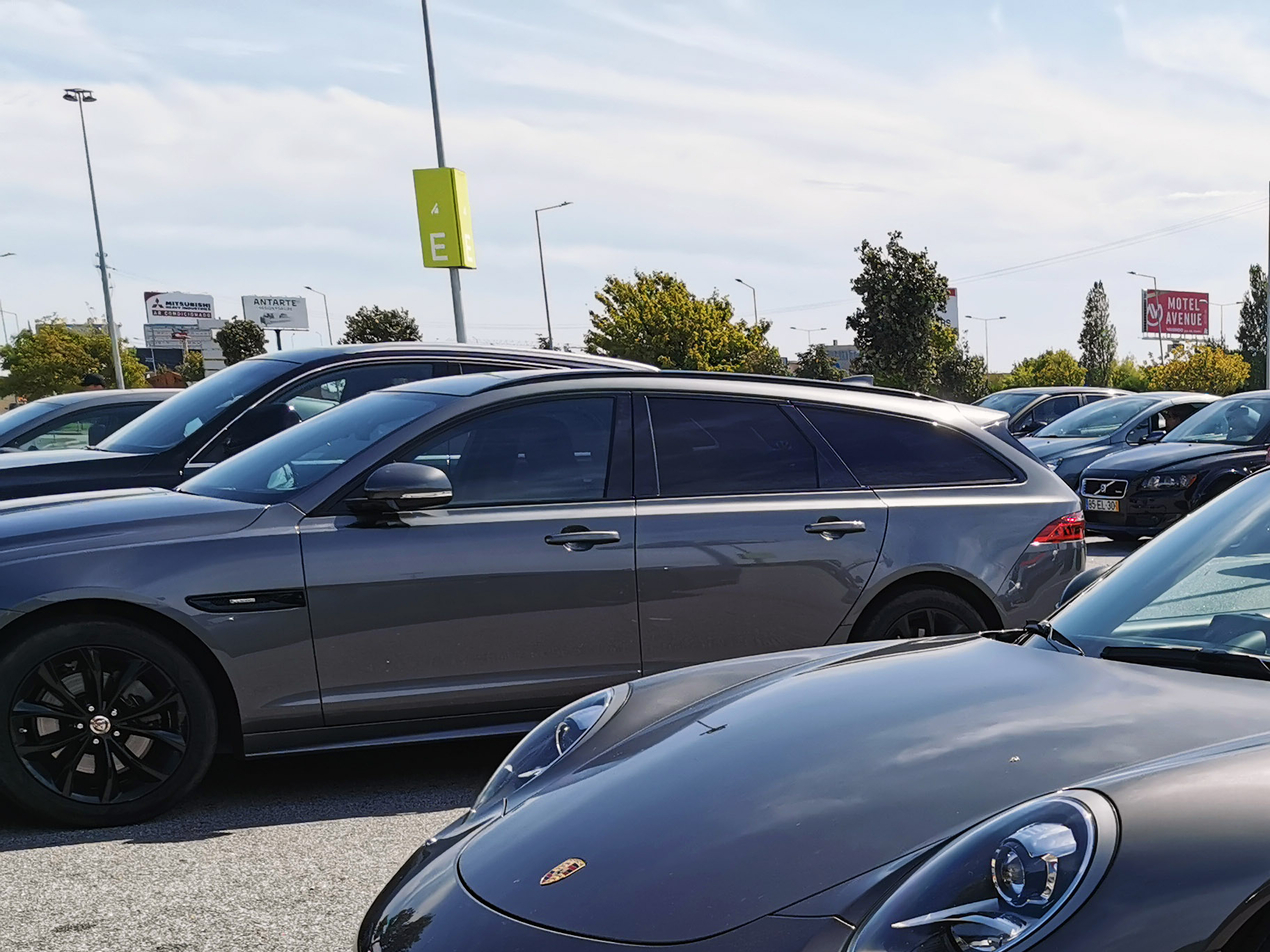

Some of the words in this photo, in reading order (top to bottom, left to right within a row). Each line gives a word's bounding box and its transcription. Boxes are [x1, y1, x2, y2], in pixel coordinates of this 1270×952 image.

[430, 232, 448, 261] E
[165, 301, 211, 309] MITSUBISHI
[254, 298, 297, 307] ANTARTE
[1167, 296, 1200, 311] MOTEL
[1165, 311, 1202, 326] AVENUE
